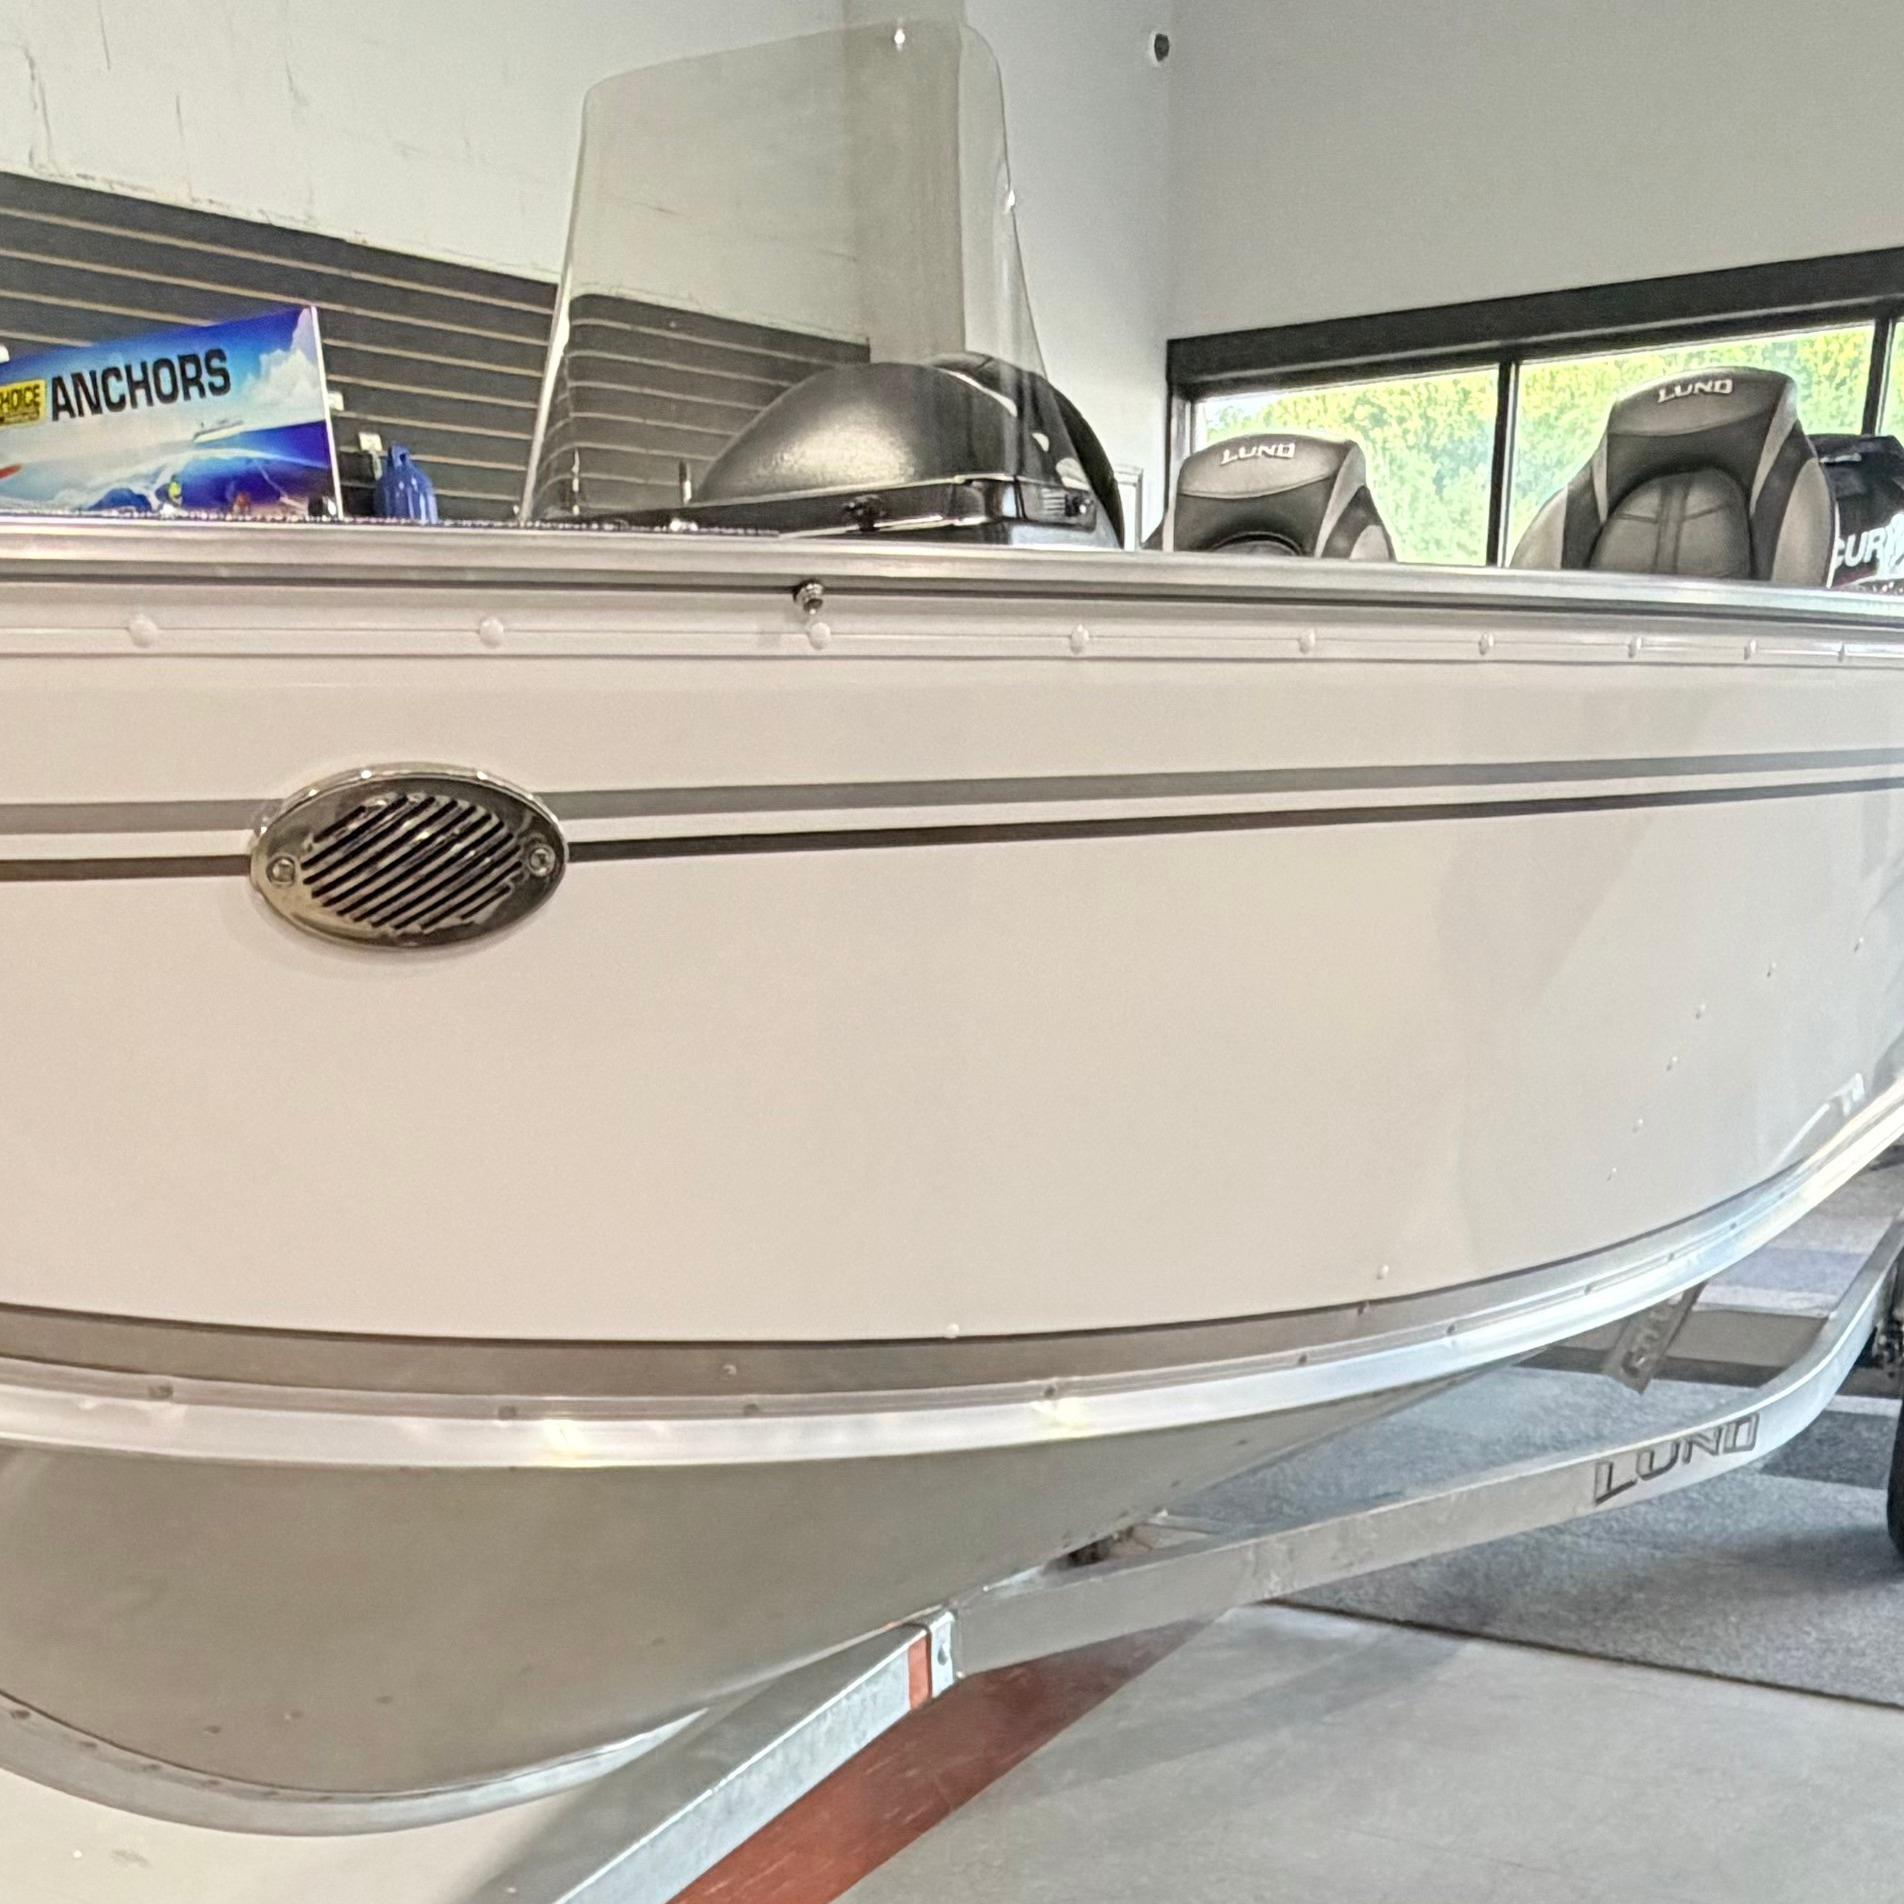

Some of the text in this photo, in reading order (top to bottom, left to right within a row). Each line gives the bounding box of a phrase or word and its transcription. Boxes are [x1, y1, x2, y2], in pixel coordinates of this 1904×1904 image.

[51, 348, 232, 422] ANCHORS
[1657, 378, 1734, 404] LUND
[1220, 442, 1296, 466] LUND
[1593, 1411, 1761, 1507] LUND
